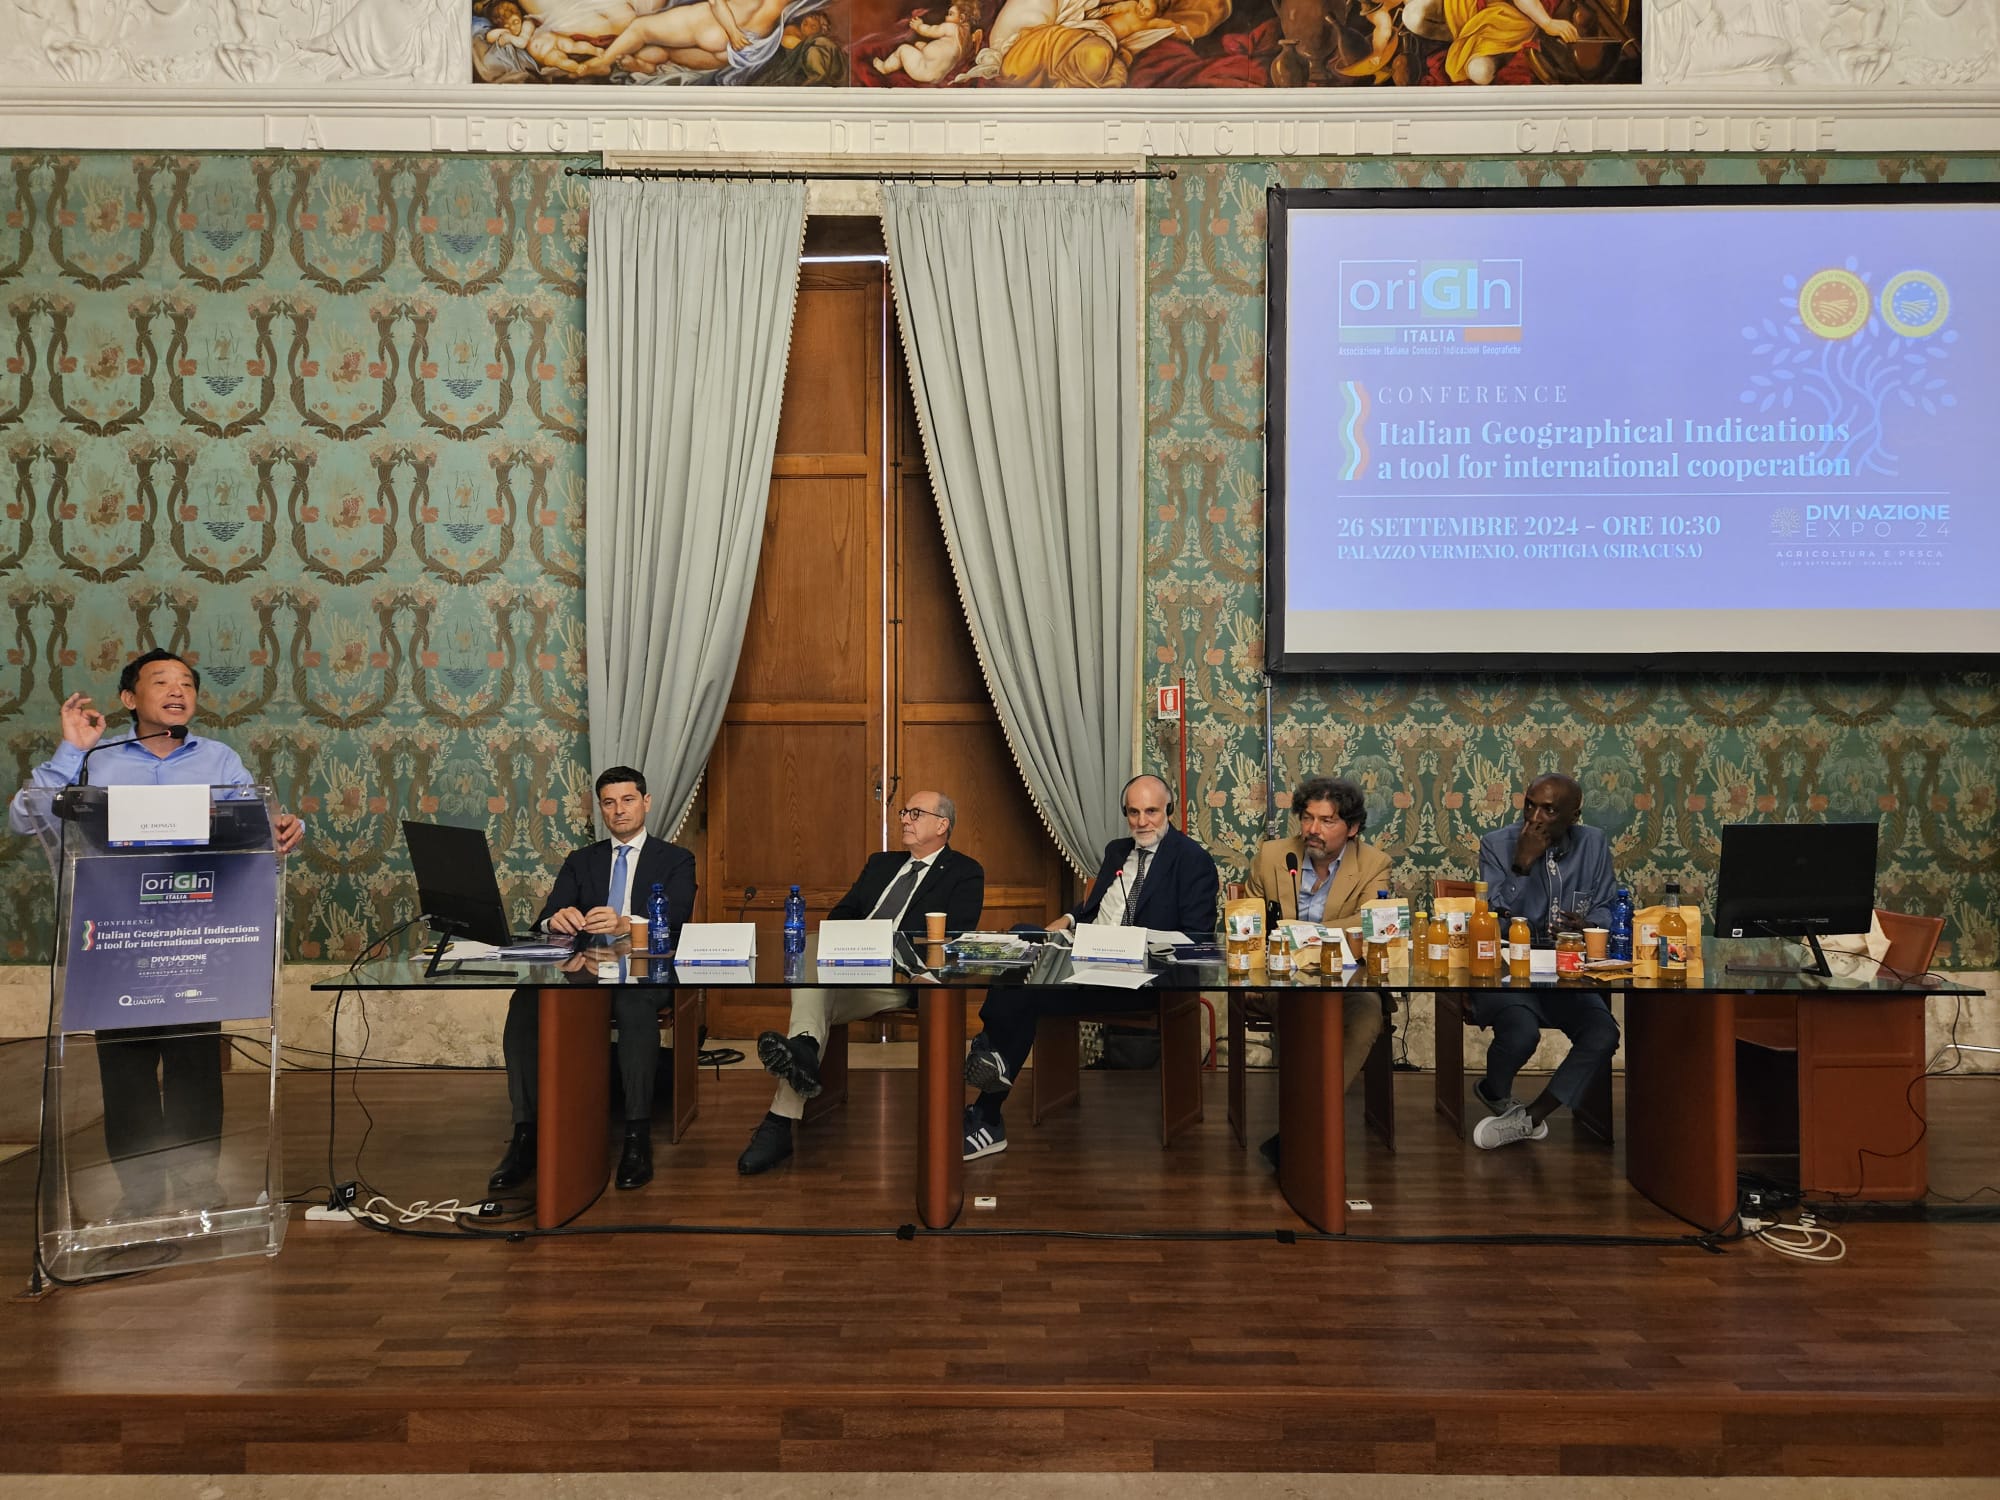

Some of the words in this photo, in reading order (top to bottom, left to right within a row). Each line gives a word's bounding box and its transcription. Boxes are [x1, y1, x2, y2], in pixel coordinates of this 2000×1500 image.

[263, 114, 325, 150] LA
[429, 115, 727, 152] LEGGENDA
[1103, 120, 1412, 157] FANCIULLE
[1515, 116, 1837, 153] CALLIPIGIE
[1349, 268, 1512, 311] oriGIn
[1403, 329, 1456, 343] ITALIA
[1377, 385, 1568, 404] CONFERENCE
[1378, 420, 1472, 446] Italian
[1481, 418, 1674, 449] Geographical
[1684, 416, 1851, 444] Indications
[1377, 461, 1392, 480] a
[1400, 454, 1451, 480] tool
[1457, 453, 1498, 479] for
[1503, 452, 1680, 478] international
[1687, 451, 1851, 482] cooperation
[1337, 517, 1365, 537] 26
[1370, 515, 1519, 537] SETTEMBRE
[1524, 515, 1580, 536] 2024
[1602, 515, 1654, 537] ORE
[1660, 515, 1721, 536] 10:30
[1806, 521, 1892, 538] EXPO
[1915, 521, 1949, 537] 24
[1337, 544, 1416, 560] PALAZZO
[1523, 543, 1600, 560] ORTIGIA
[1603, 542, 1703, 559] (SIRACUSA)
[1776, 550, 1876, 558] AGRICOLTURA
[145, 874, 210, 890] oriGIn
[97, 919, 155, 927] CONFERENCE
[97, 930, 131, 940] Italian
[133, 926, 201, 939] Geographical
[204, 925, 260, 935] Indications
[104, 940, 123, 950] tool
[124, 940, 140, 949] for
[141, 936, 203, 948] international
[204, 935, 260, 947] cooperation
